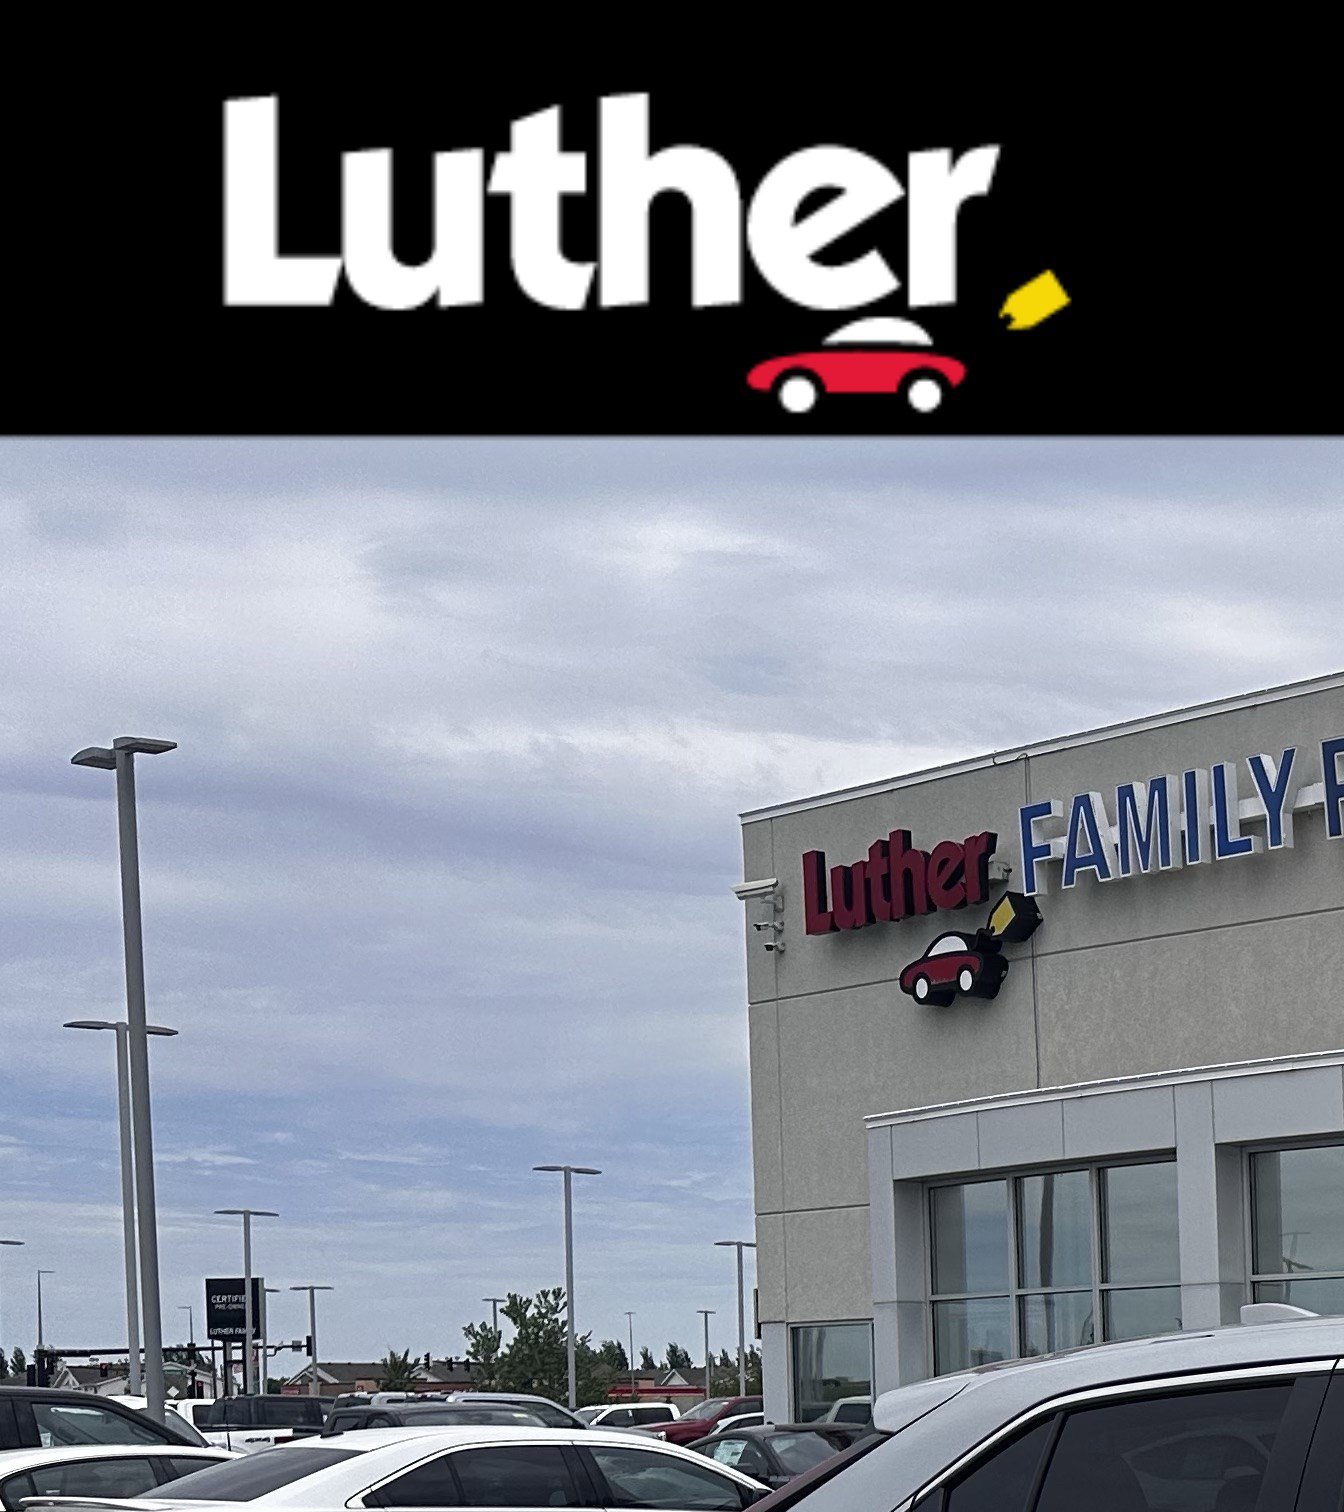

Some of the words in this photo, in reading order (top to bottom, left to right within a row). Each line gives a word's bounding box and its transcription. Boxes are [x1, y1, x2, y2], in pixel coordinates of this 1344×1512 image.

[1019, 747, 1298, 897] FAMILY
[803, 829, 998, 935] Luther
[211, 1295, 247, 1303] CERTIFIE
